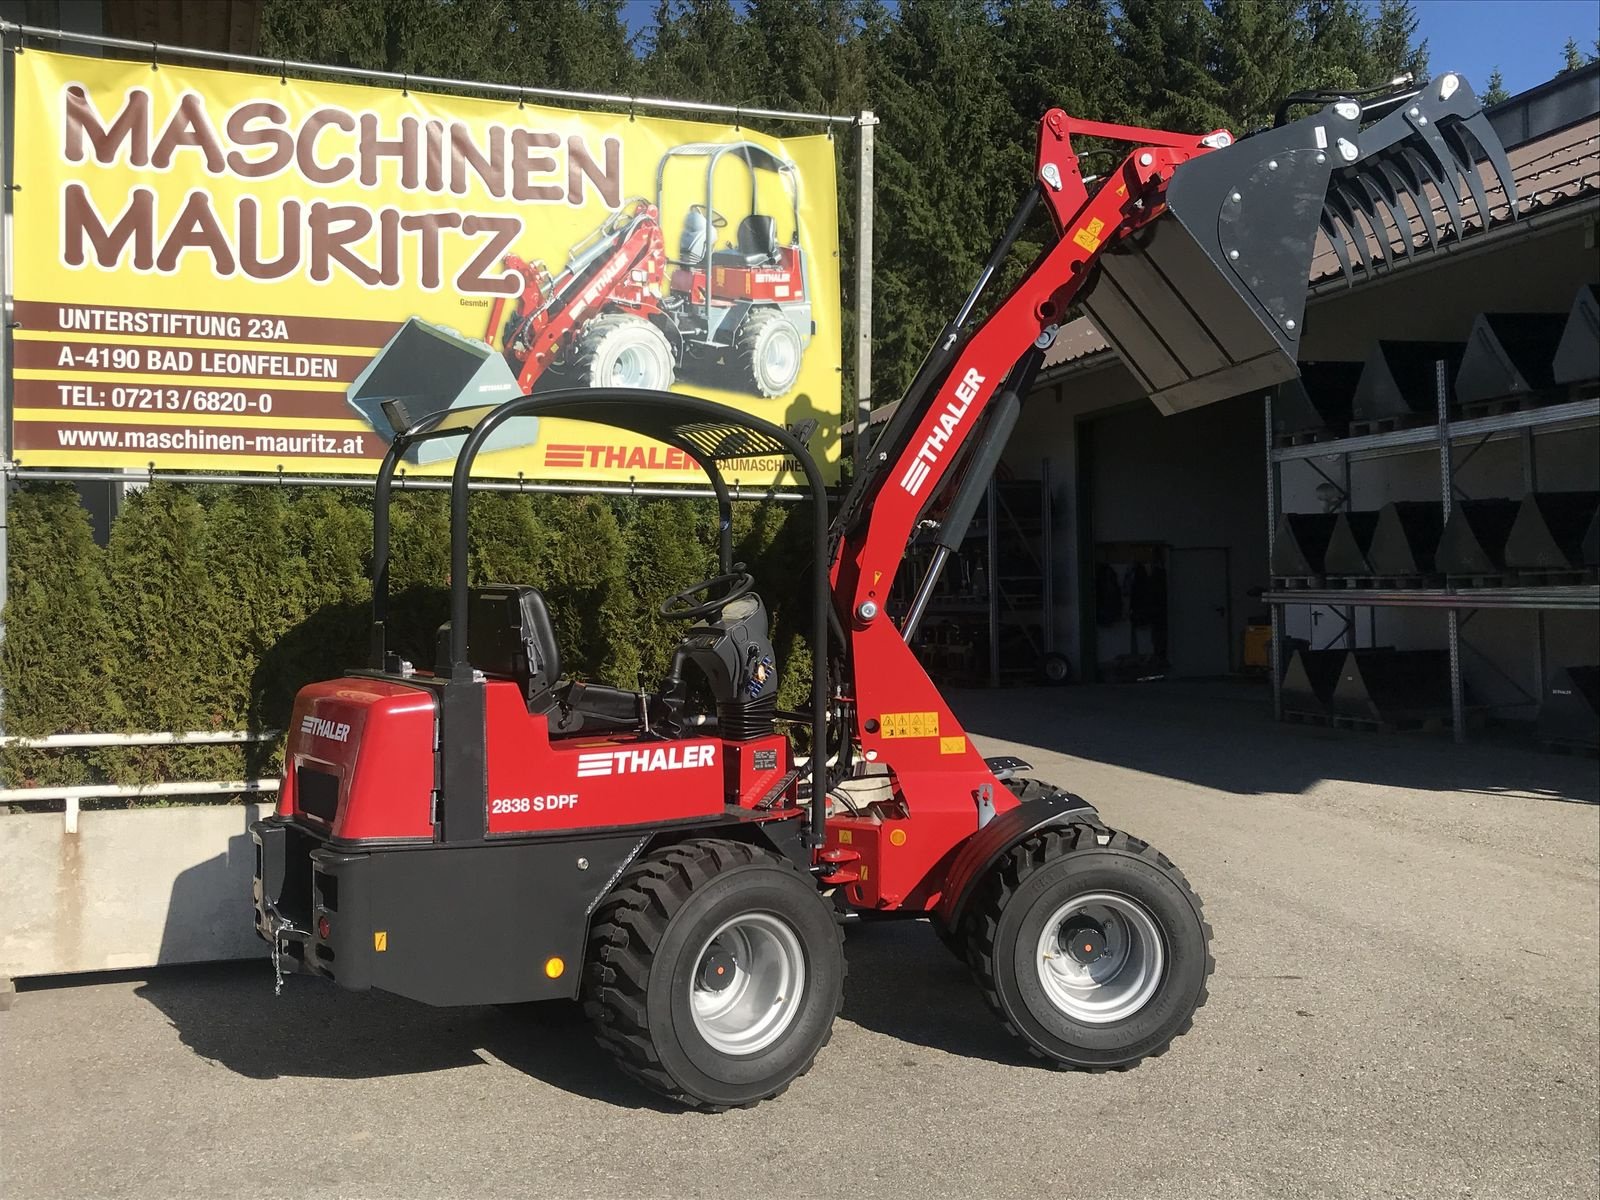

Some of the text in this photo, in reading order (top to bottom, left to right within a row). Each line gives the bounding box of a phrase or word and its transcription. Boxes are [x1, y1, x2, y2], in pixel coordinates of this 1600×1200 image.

[64, 85, 621, 208] MASCHINEN
[64, 184, 523, 294] MAURITZ
[460, 298, 489, 308] GesmbH
[58, 309, 289, 340] UNTERSTIFTUNG 23A
[58, 346, 338, 378] A-4190 BAD LEONFELDEN
[58, 385, 106, 408] TEL:
[917, 366, 986, 463] THALER
[58, 429, 364, 455] www.maschinen-mauritz.at
[312, 718, 350, 743] THALER
[613, 744, 716, 774] THALER
[492, 798, 530, 814] 2838
[546, 794, 578, 810] DPF
